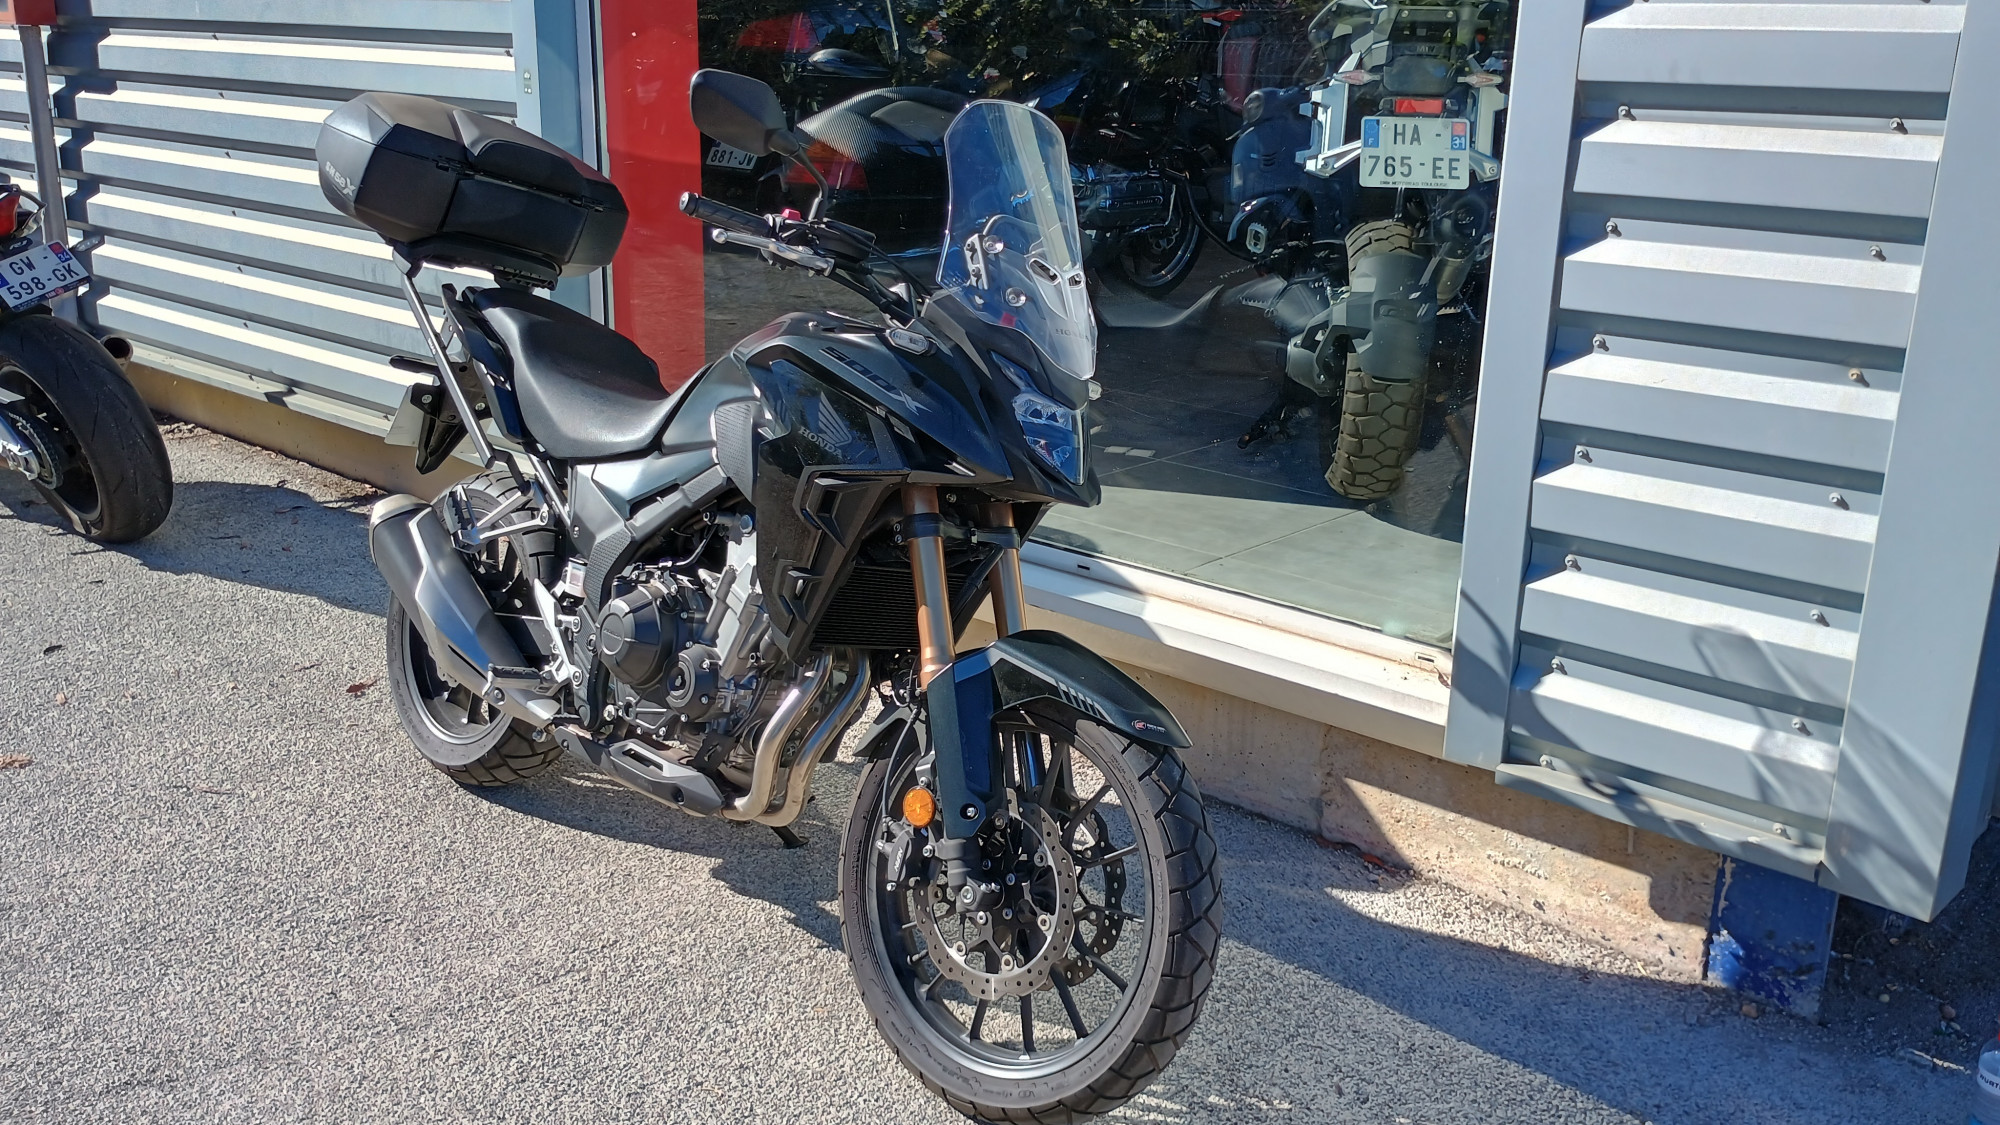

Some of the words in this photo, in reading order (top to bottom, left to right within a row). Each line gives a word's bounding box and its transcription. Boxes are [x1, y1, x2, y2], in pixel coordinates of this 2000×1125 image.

[1393, 123, 1422, 146] HA
[1451, 136, 1466, 149] 31
[1367, 155, 1461, 180] 765-EE
[8, 255, 37, 276] GW
[57, 252, 71, 262] 34
[6, 262, 80, 300] 598-GK
[799, 426, 843, 459] HONDA
[1979, 1074, 2000, 1090] WURT
